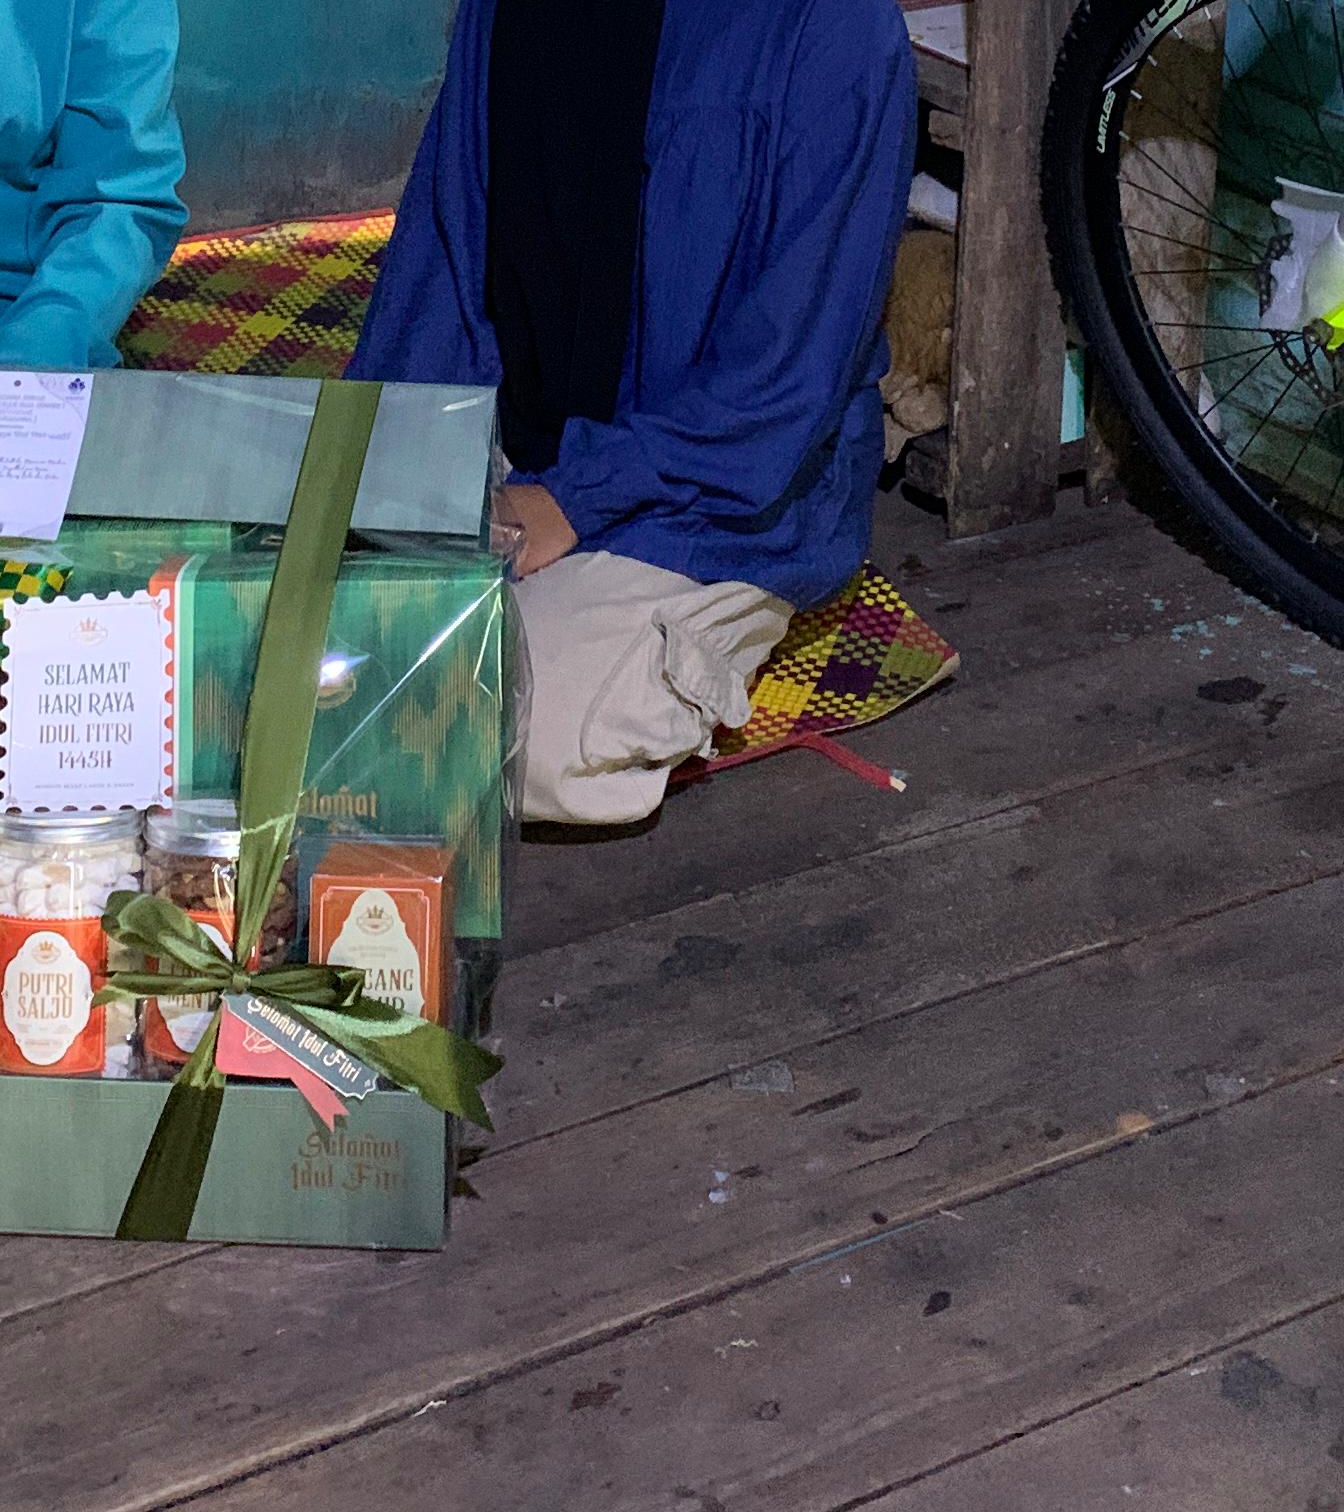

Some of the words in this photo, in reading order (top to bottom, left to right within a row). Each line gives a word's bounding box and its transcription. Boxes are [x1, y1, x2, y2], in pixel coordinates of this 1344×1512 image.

[44, 661, 131, 686] SELAMAT
[38, 692, 83, 716] HARI
[88, 691, 135, 716] RAYA
[39, 723, 81, 745] IDUL
[86, 722, 133, 745] FITRI
[58, 750, 112, 770] 1445H
[18, 972, 74, 996] PUTRI
[17, 996, 74, 1020] SALJU
[298, 1029, 329, 1058] Idul
[323, 1048, 362, 1083] Fitri
